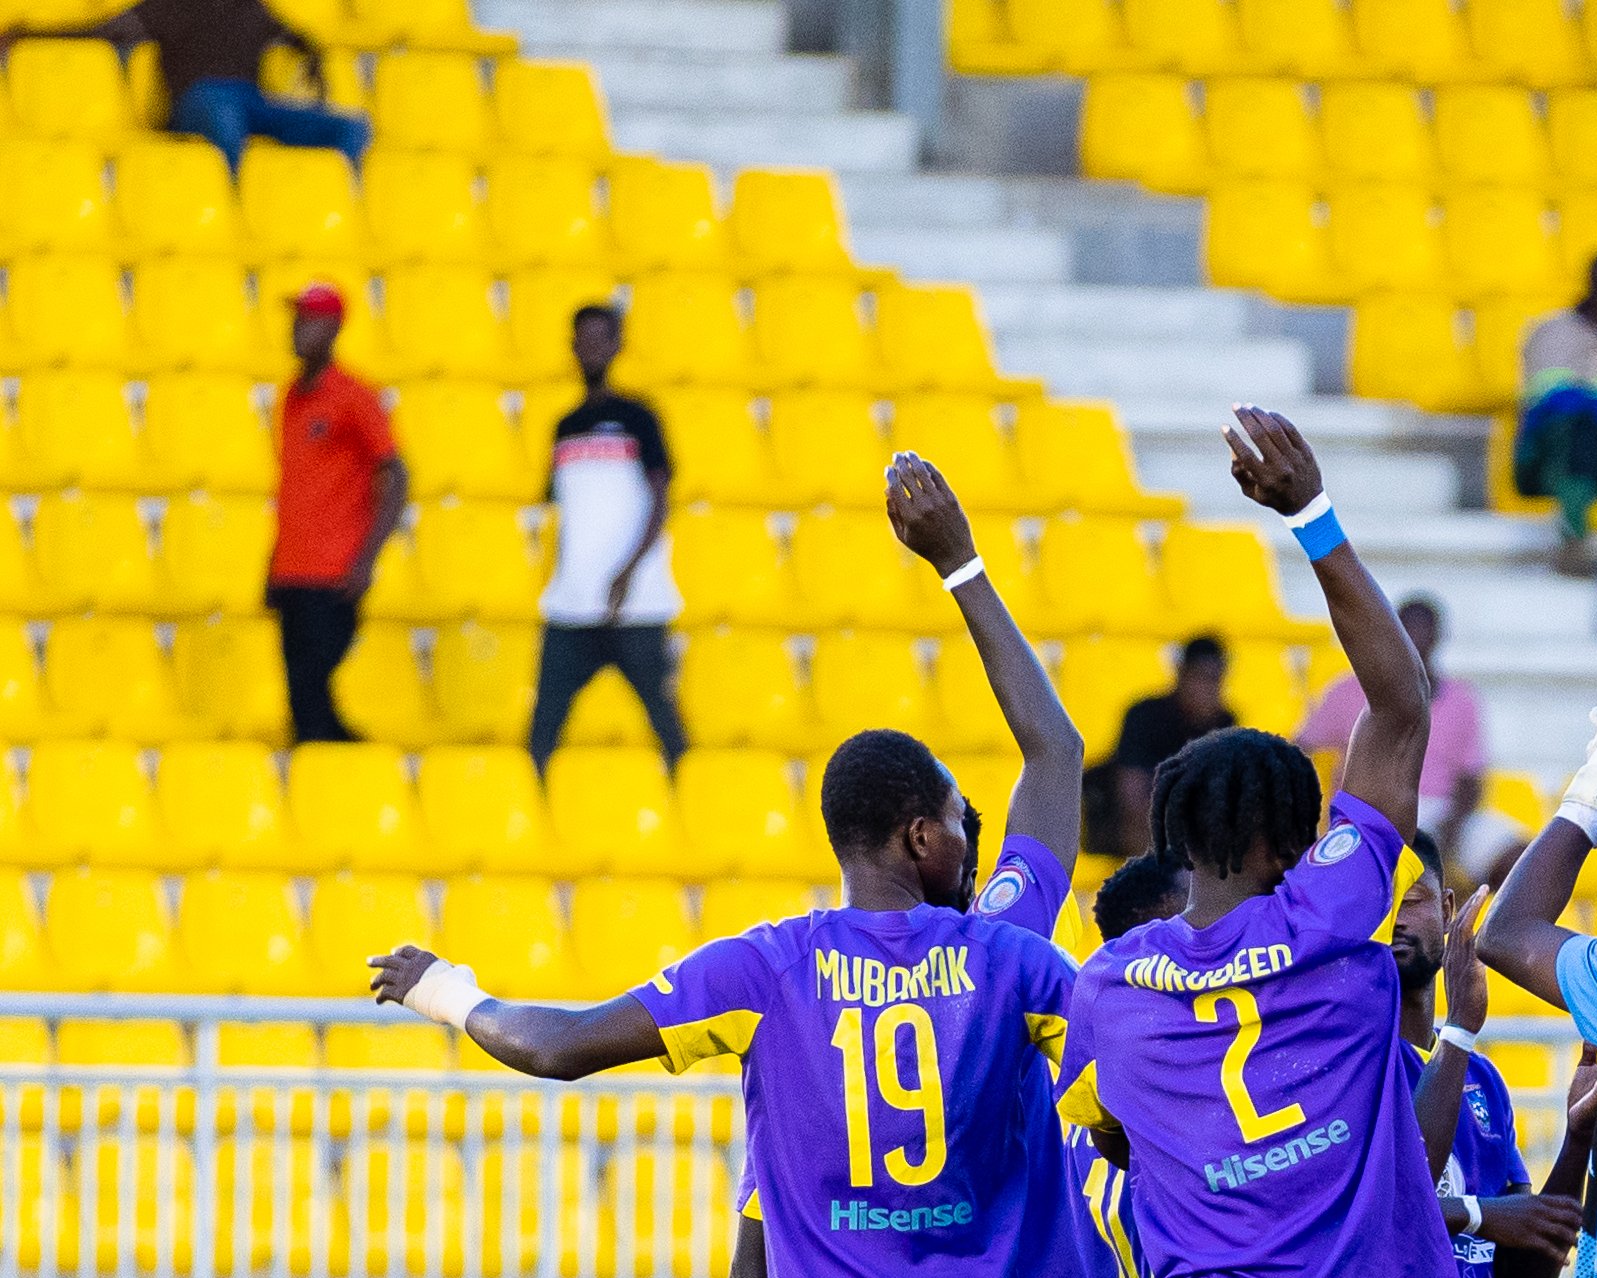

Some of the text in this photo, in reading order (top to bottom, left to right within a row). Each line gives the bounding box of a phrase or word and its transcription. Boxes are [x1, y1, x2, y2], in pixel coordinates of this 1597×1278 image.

[815, 946, 976, 1008] MUBARAK
[831, 1003, 948, 1188] 19
[1193, 987, 1307, 1144] 2
[1204, 1119, 1351, 1193] Hisense
[831, 1200, 973, 1232] Hisense
